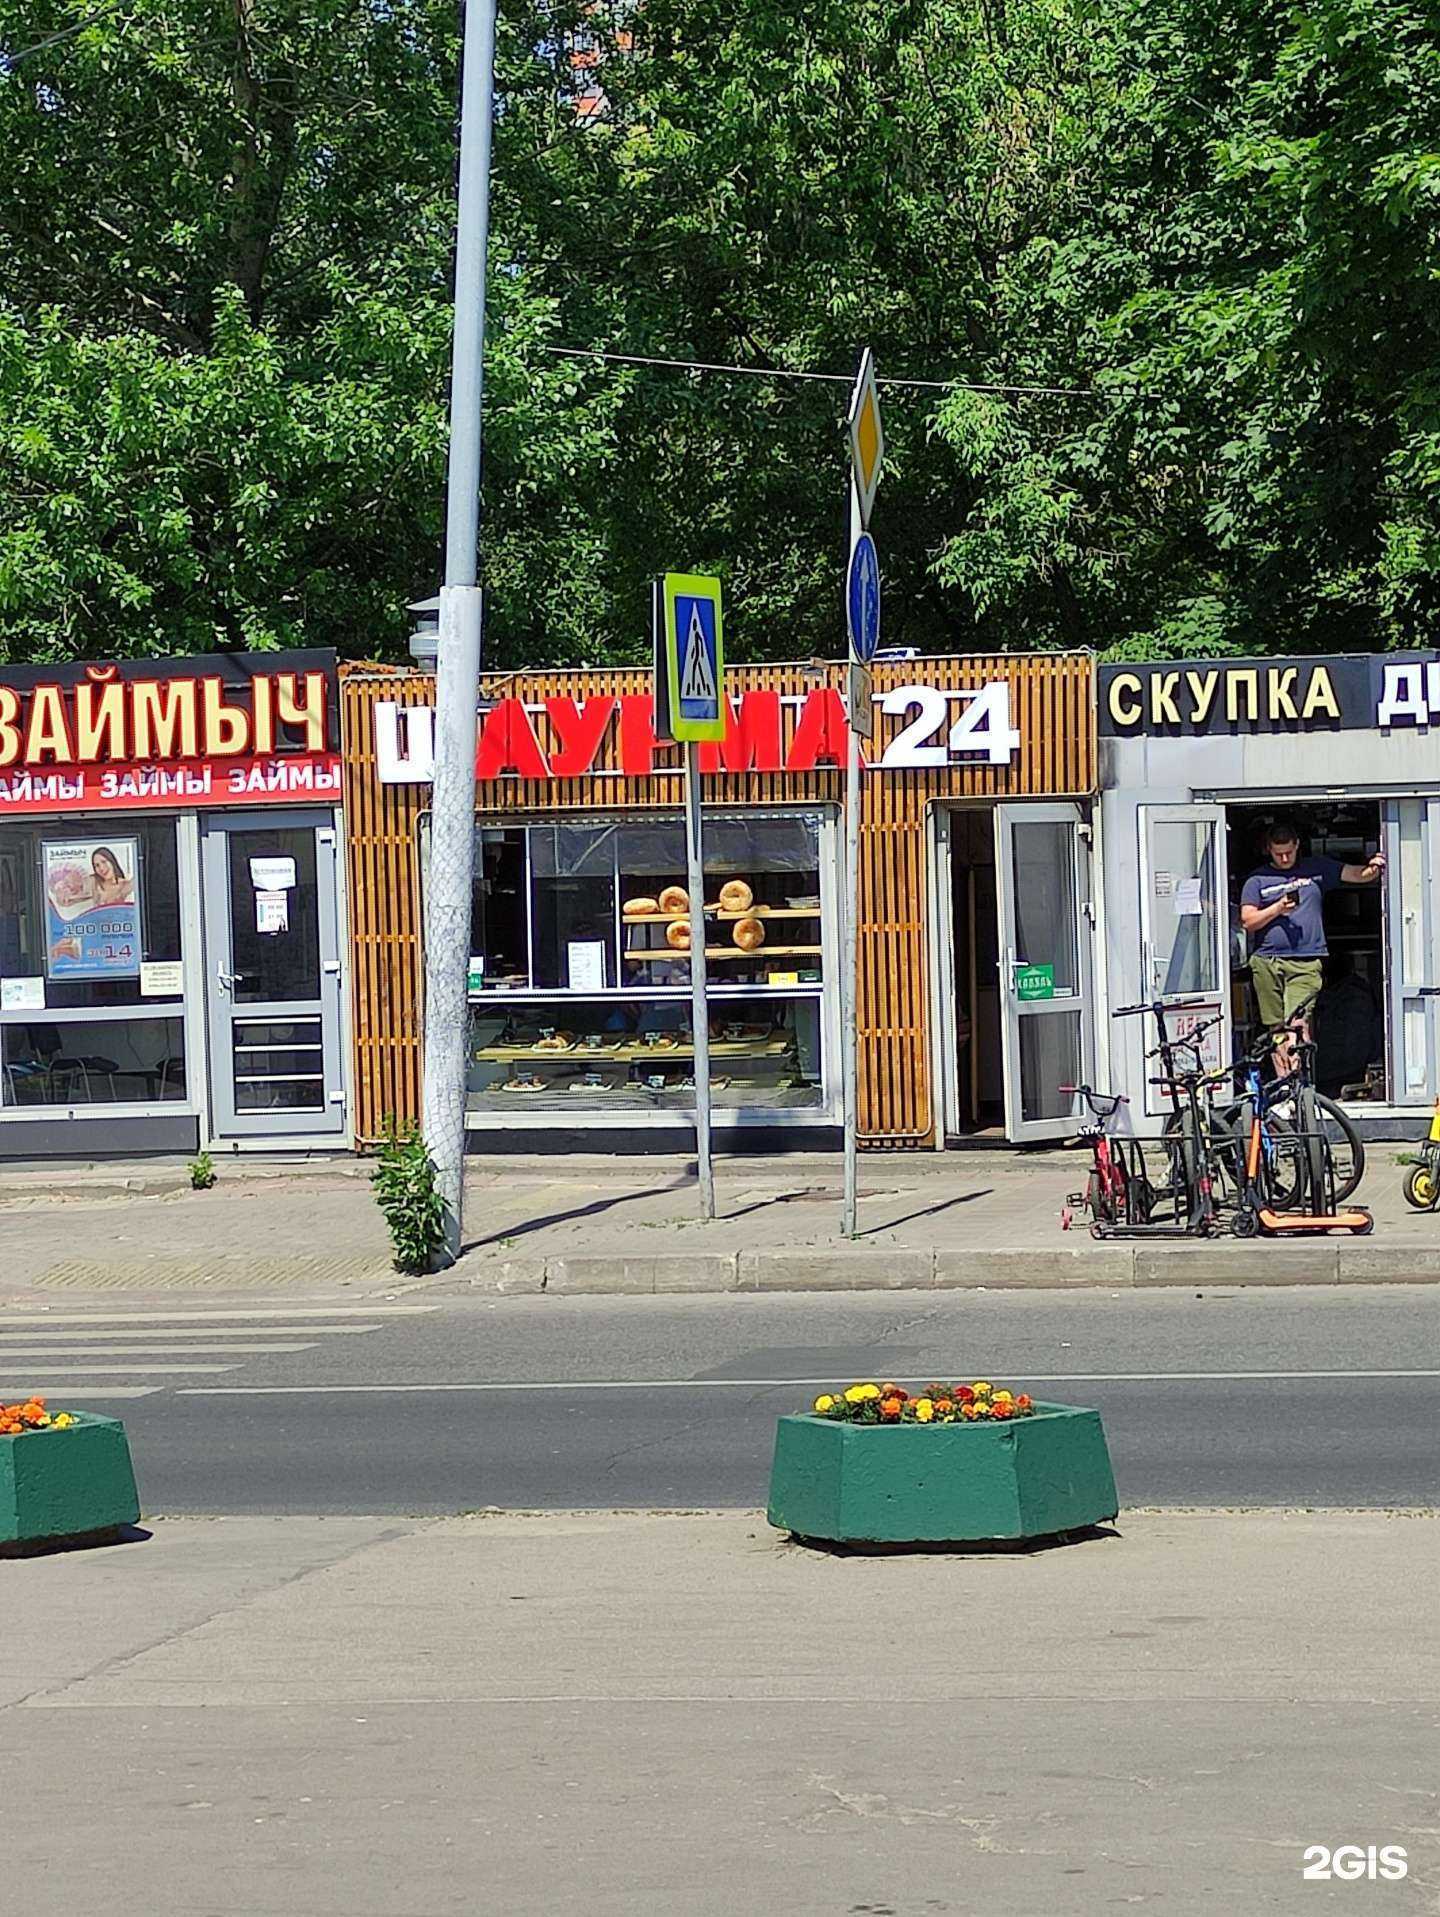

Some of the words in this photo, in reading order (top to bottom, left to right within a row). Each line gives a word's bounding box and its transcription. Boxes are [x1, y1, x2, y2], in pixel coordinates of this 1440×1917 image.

[0, 665, 327, 766] ЗАЙМЫЧ
[881, 681, 1020, 768] 24
[1108, 665, 1341, 726] СКУПКА
[100, 764, 212, 799] ЗАЙМЫ
[228, 759, 341, 795] ЗАЙМЫ
